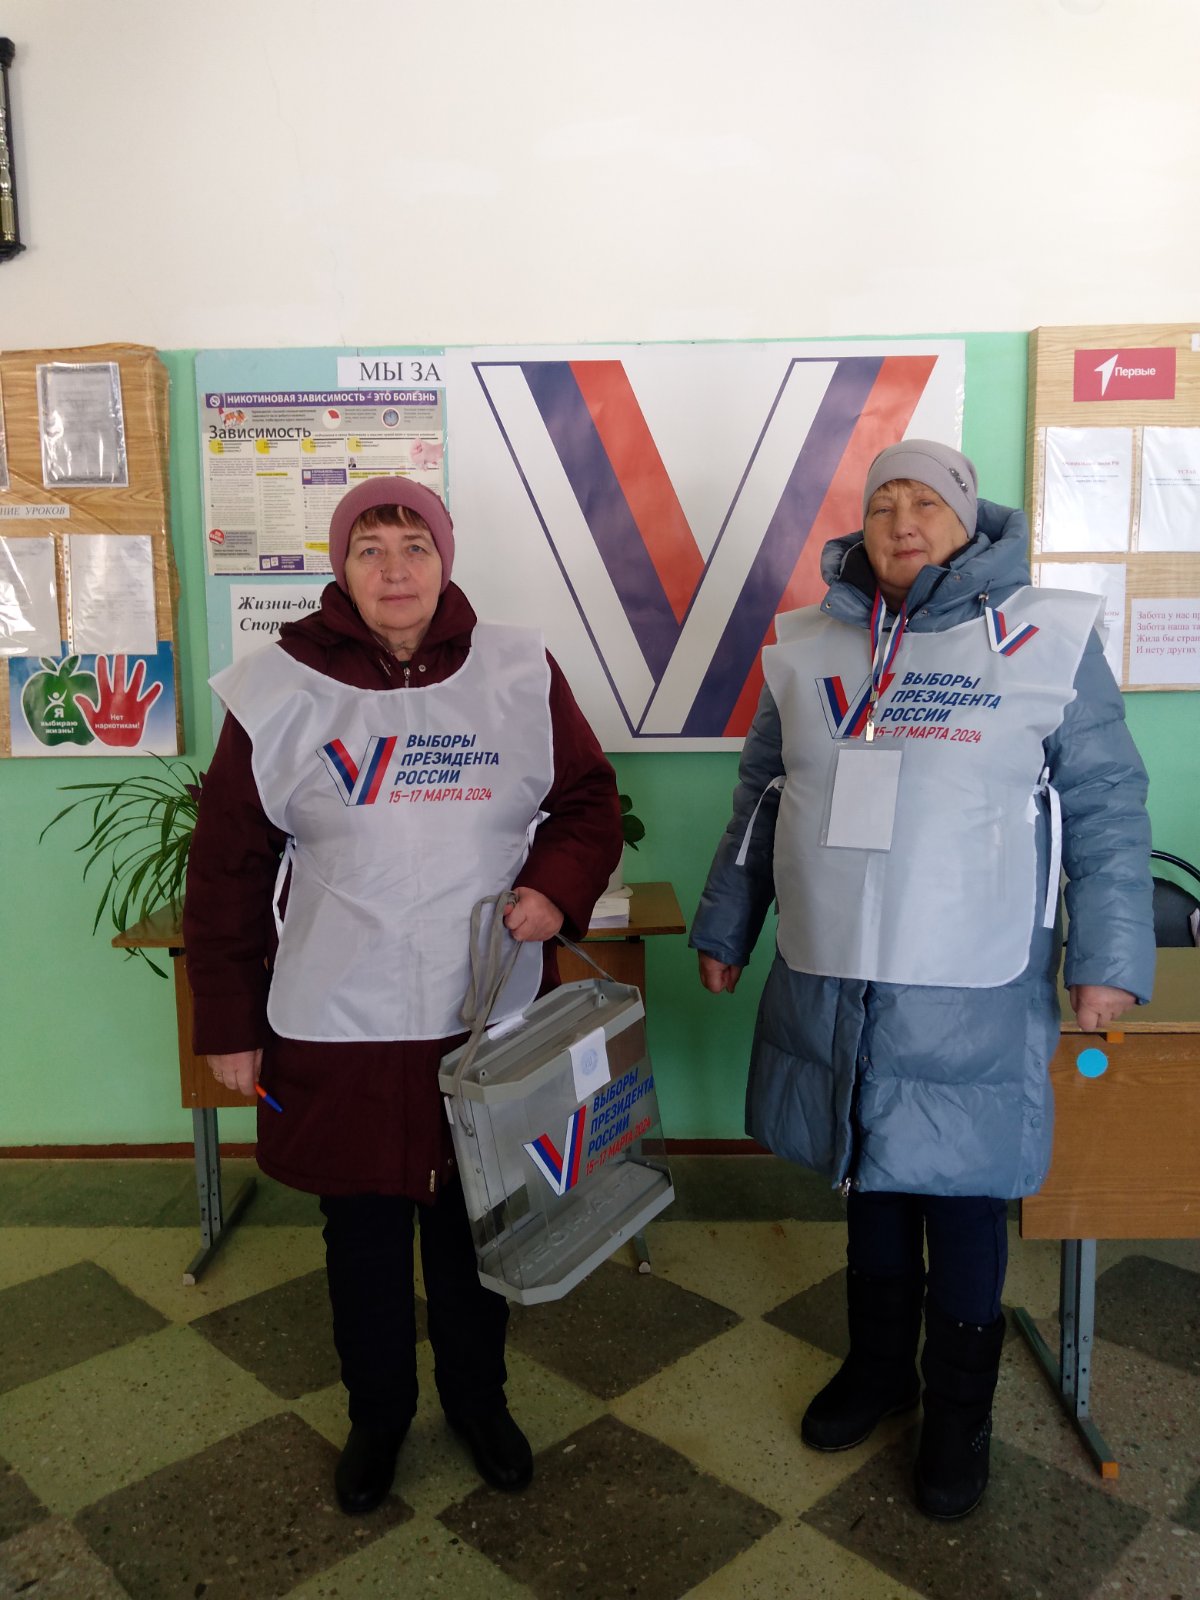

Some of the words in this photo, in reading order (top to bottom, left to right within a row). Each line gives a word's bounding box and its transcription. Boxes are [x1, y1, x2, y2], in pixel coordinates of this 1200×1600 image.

[360, 362, 403, 381] МЫ
[411, 361, 442, 381] ЗА
[1115, 366, 1156, 379] Первые
[227, 393, 295, 405] НИКОТИНОВАЯ
[297, 391, 365, 404] ЗАВИСИМОСТЬ
[373, 392, 391, 402] ЭТО
[393, 391, 436, 402] БОЛЕЗНЬ
[209, 425, 311, 439] Зависимость
[26, 505, 66, 515] УРОКОВ
[238, 596, 321, 610] Жизни-да!
[1136, 611, 1165, 619] Забота
[1168, 612, 1173, 621] у
[240, 617, 287, 634] Спор
[1136, 623, 1165, 631] Забота
[1136, 634, 1160, 642] Жила
[1162, 634, 1174, 642] бы
[1167, 648, 1196, 656] других
[902, 671, 982, 689] ВЫБОРЫ
[891, 690, 1002, 709] ПРЕЗИДЕНТА
[54, 707, 64, 718] Я
[110, 713, 124, 721] Нет
[880, 708, 952, 722] РОССИИ
[40, 720, 78, 728] выбираю
[95, 722, 140, 730] наркотикам!
[406, 734, 476, 748] ВЫБОРЫ
[906, 725, 950, 740] МАРТА
[950, 728, 982, 743] 2024
[401, 751, 500, 767] ПРЕЗИДЕНТА
[394, 770, 460, 786] РОССИИ
[423, 789, 463, 802] МАРТА
[465, 788, 492, 801] 2024
[593, 1067, 638, 1113] ВЫБОРЫ
[590, 1074, 654, 1136] ПРЕЗИДЕНТА
[587, 1113, 630, 1158] РОССИИ
[607, 1130, 633, 1159] МАРТА
